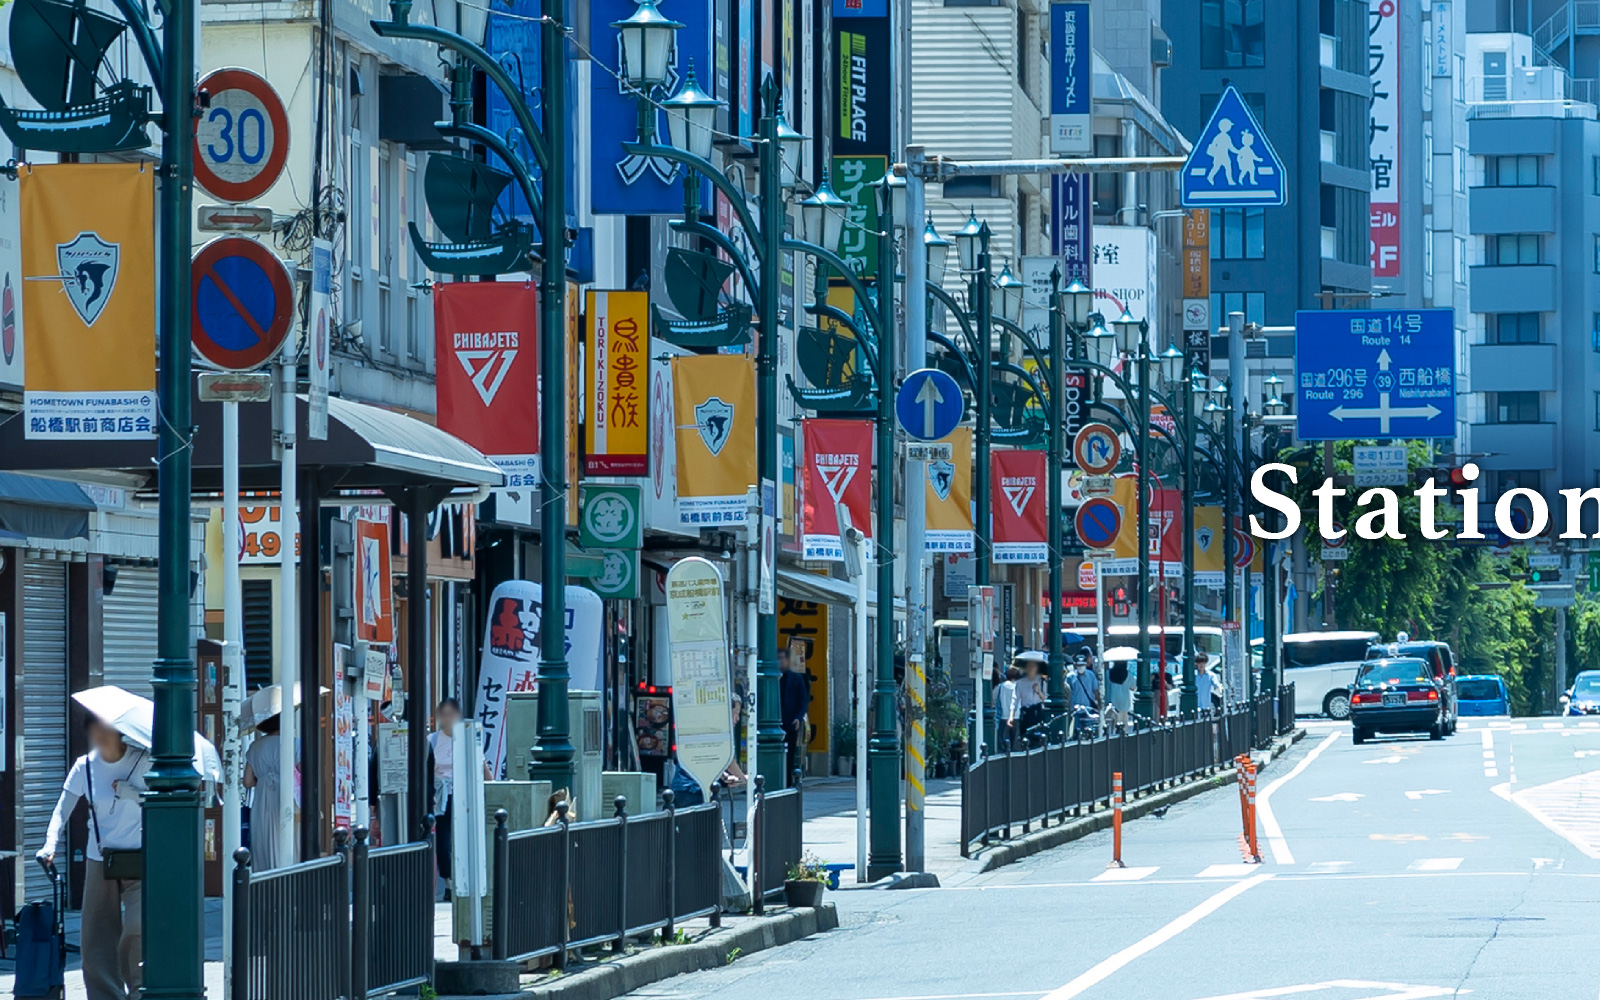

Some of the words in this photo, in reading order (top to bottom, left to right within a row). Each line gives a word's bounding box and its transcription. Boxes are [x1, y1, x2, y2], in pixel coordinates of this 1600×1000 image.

[1065, 11, 1076, 108] 近畿日本ツーリスト
[852, 56, 866, 83] FIT
[852, 84, 866, 142] PLACE
[208, 107, 265, 164] 30
[1113, 289, 1144, 300] SHOP
[1351, 314, 1423, 333] 国道14号
[453, 332, 519, 349] CHIBAJETS
[1362, 336, 1391, 345] Route
[1400, 335, 1411, 344] 14
[597, 317, 605, 423] TORIKIZOKU
[1302, 369, 1368, 387] 国道296号
[1400, 368, 1451, 386] 西船橋
[1378, 376, 1391, 391] 39
[1306, 391, 1334, 399] Route
[1343, 390, 1364, 399] 296
[1400, 388, 1451, 398] Nishifunabashi
[30, 416, 150, 433] 船橋駅前商店会
[815, 453, 859, 465] CHIBAJETS
[1357, 450, 1403, 460] 本町1丁目
[1358, 475, 1404, 484] スクランブル
